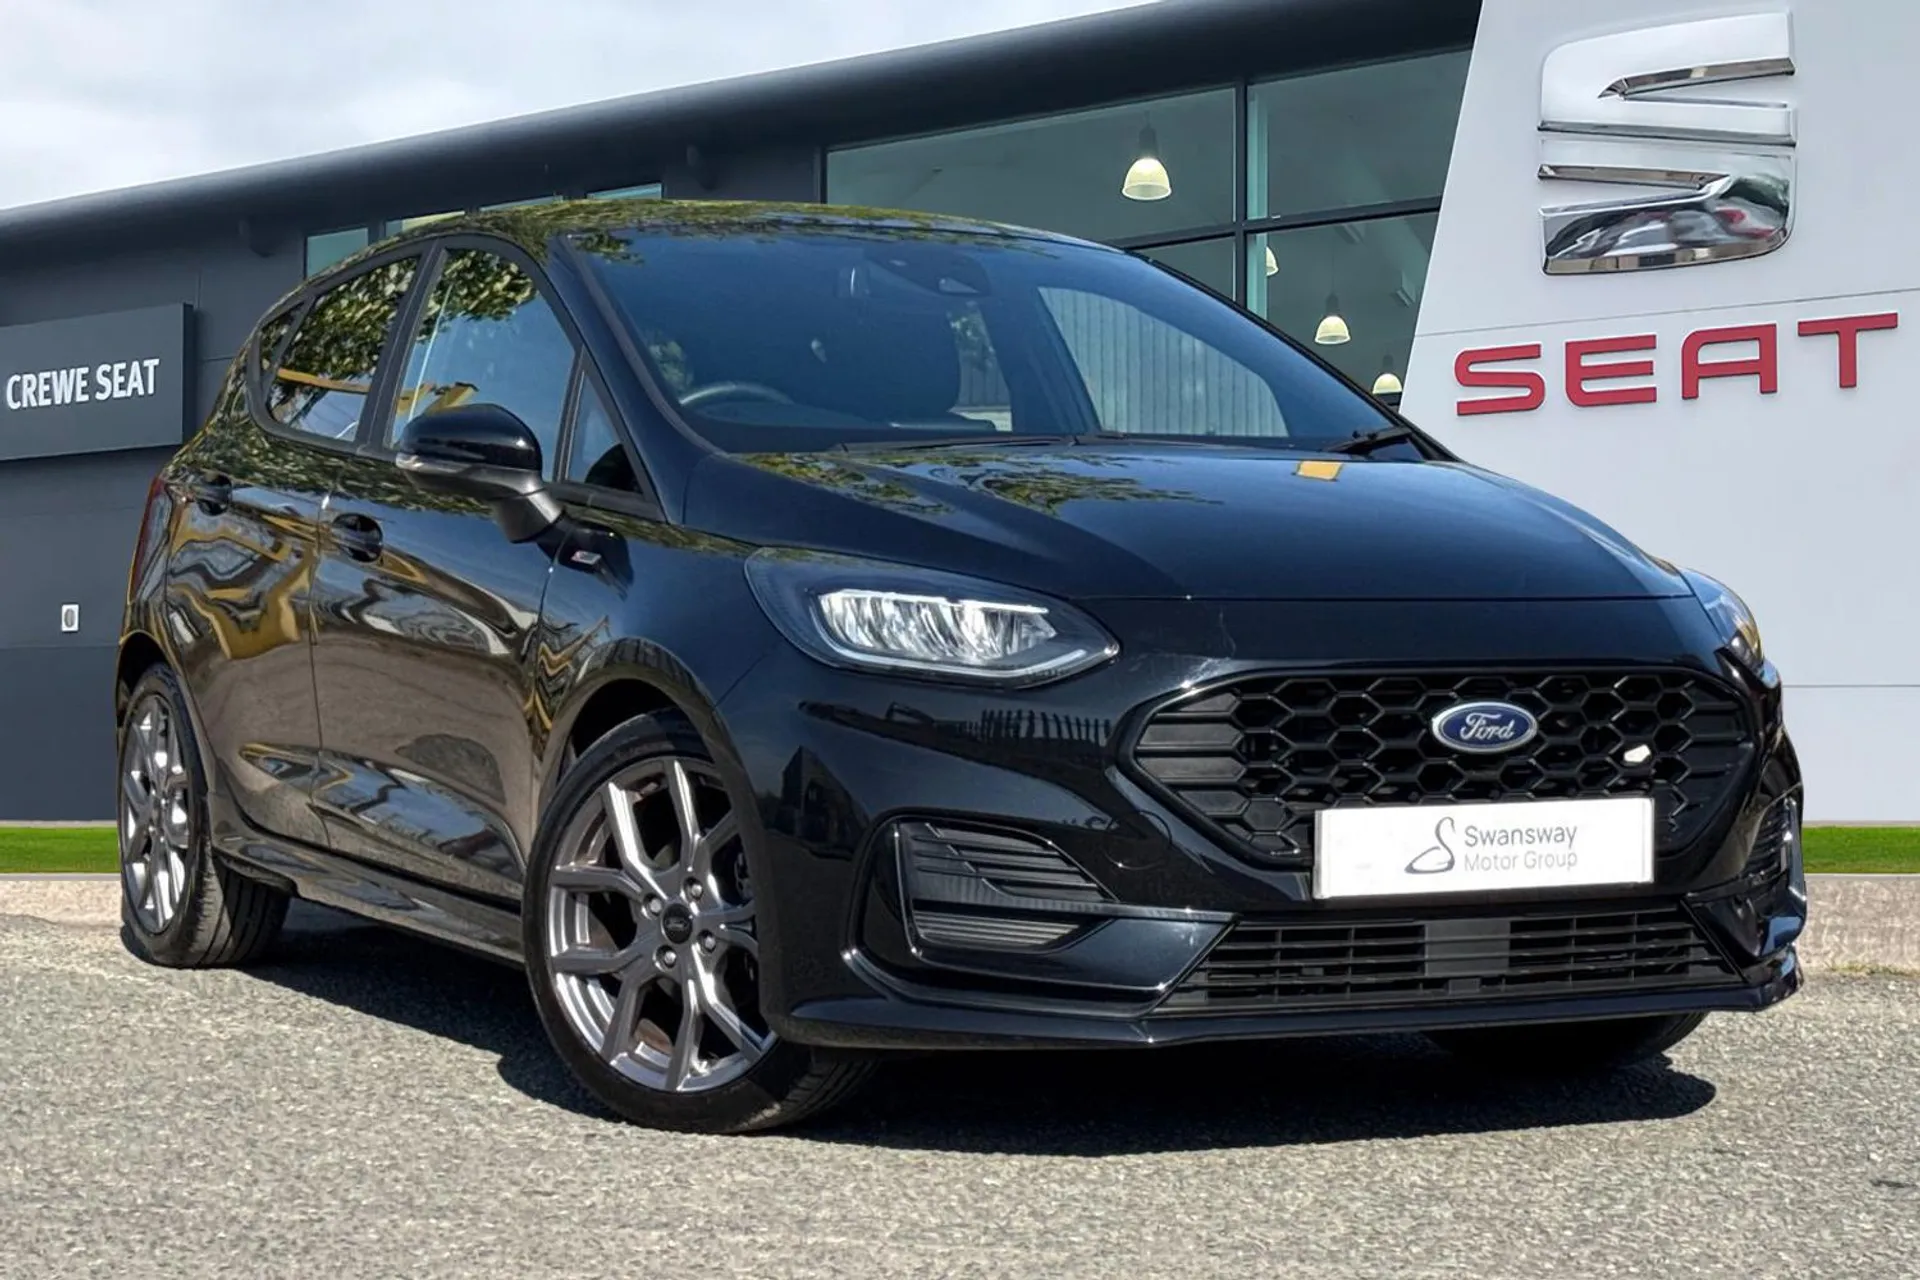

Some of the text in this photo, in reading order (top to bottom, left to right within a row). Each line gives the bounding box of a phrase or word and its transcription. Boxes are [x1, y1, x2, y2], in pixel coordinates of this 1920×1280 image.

[1454, 312, 1899, 416] SEAT
[6, 358, 160, 410] CREWE SEAT
[1460, 712, 1515, 740] Ford
[1464, 825, 1578, 850] Swansway
[1464, 850, 1578, 872] Motor Group
